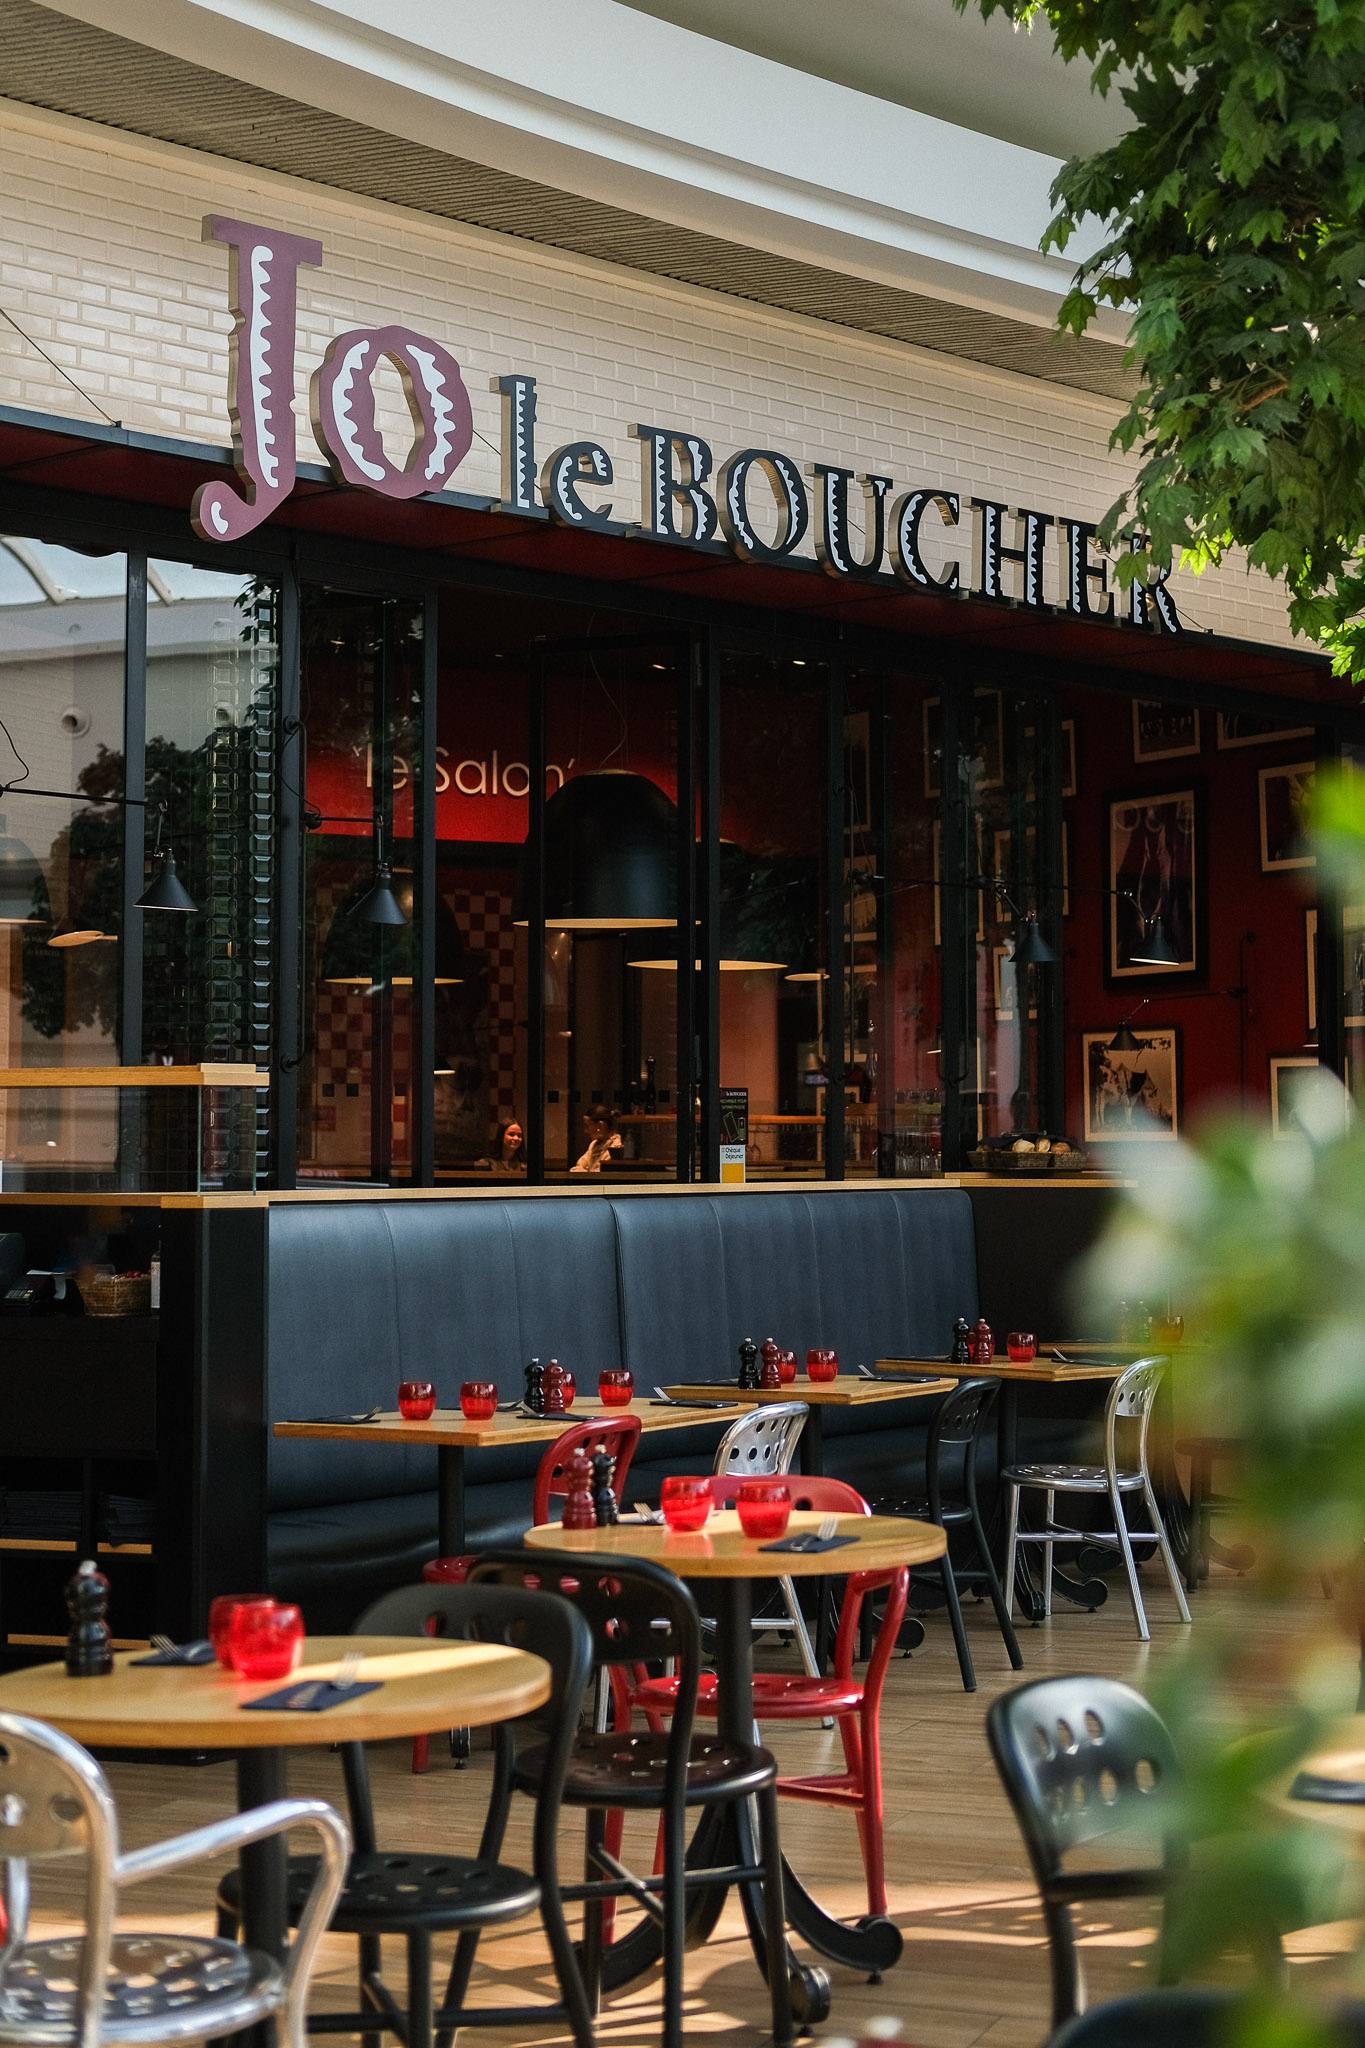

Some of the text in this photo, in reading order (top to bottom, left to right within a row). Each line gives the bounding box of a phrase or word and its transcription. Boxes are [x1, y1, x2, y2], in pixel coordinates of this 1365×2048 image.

[191, 213, 1186, 635] Jo le BOUCHER
